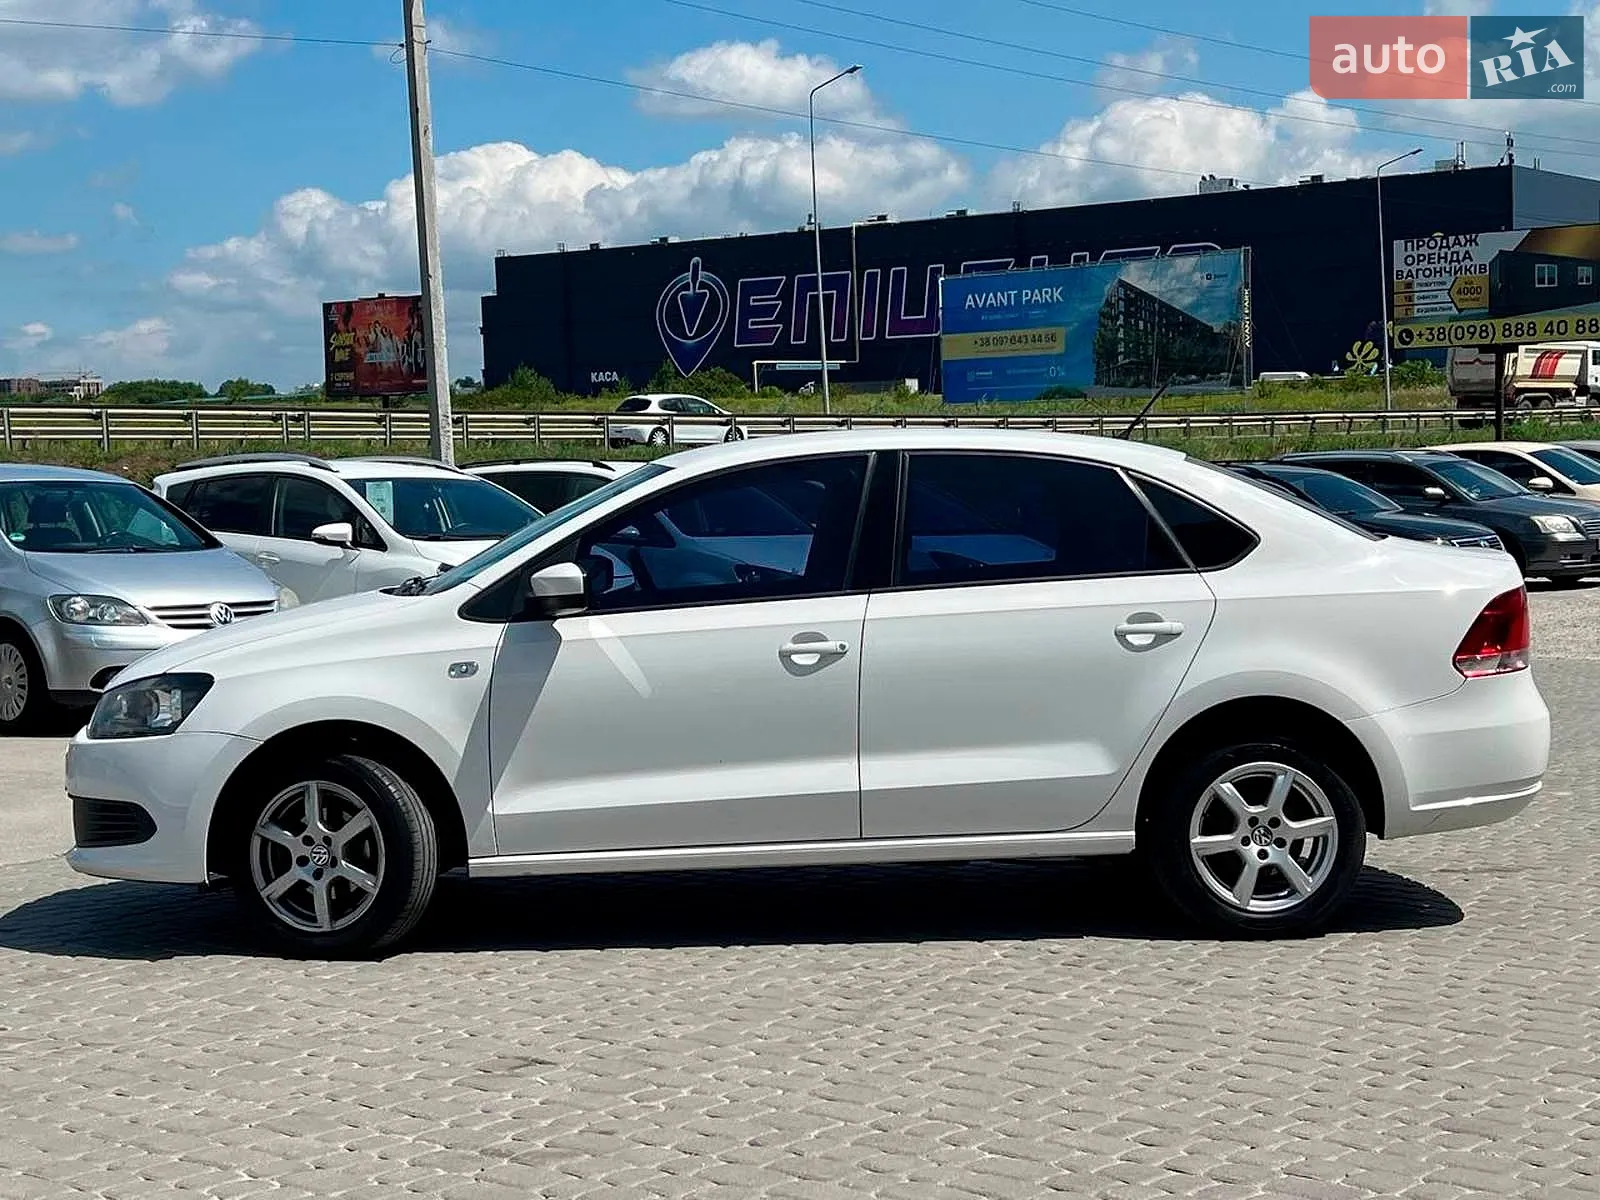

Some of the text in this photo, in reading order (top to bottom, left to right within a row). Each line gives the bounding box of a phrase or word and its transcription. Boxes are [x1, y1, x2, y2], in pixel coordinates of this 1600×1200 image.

[1404, 233, 1480, 252] ПРОДАЖ
[1404, 250, 1474, 266] ОРЕНДА
[1396, 263, 1488, 281] ВАГОНЧИКІВ
[965, 286, 1064, 310] AVANT PARK
[1416, 318, 1600, 345] +38(098) 888 40 88
